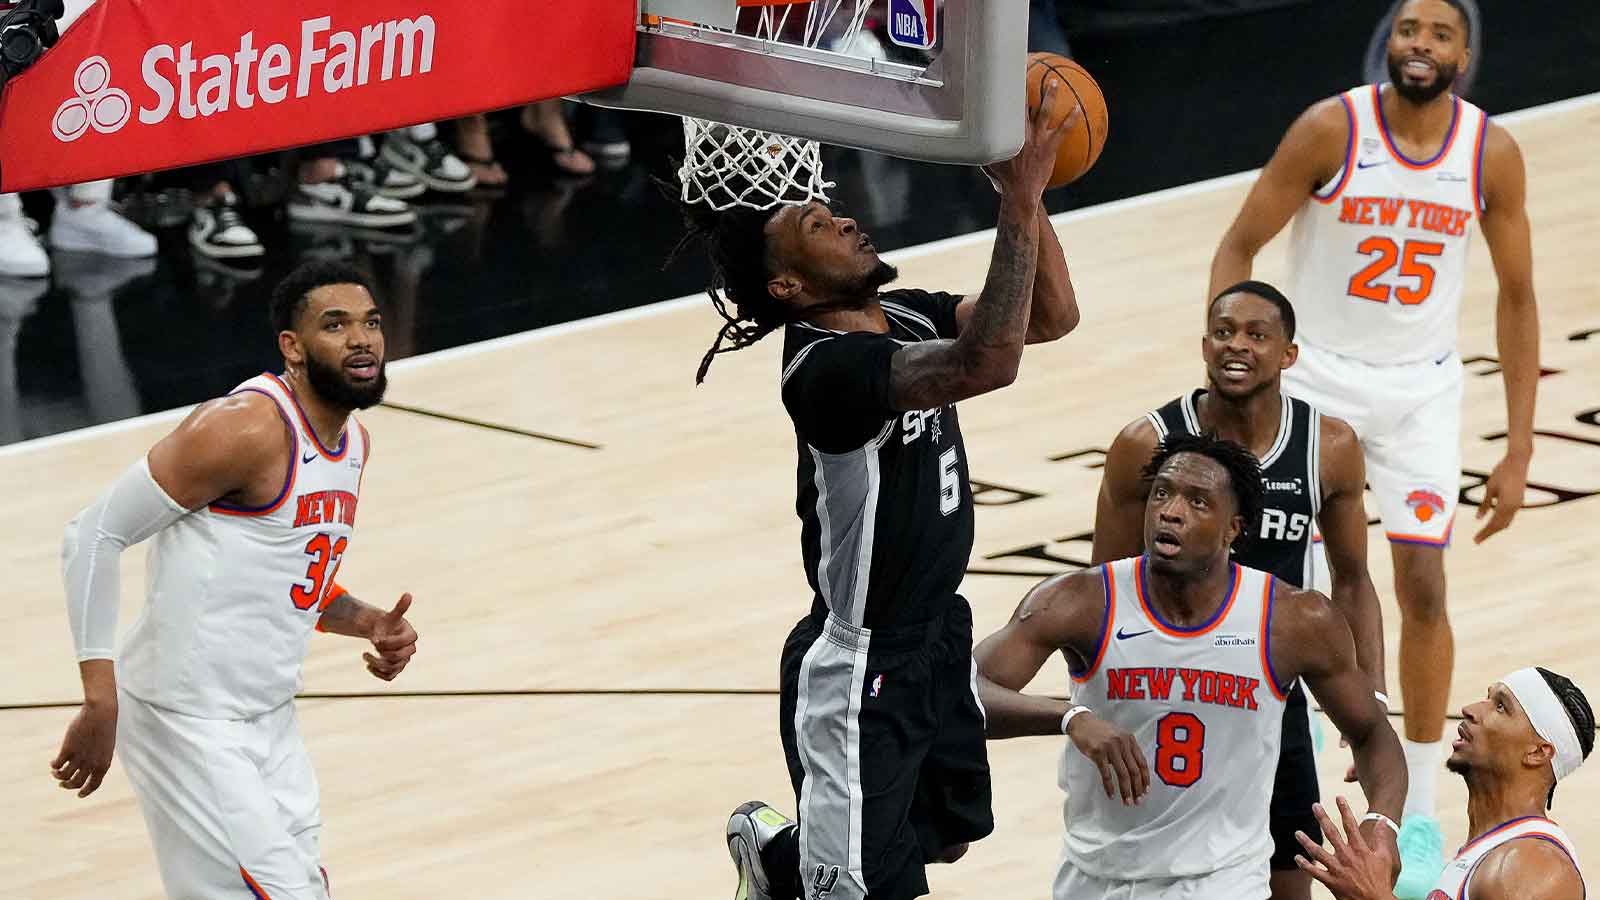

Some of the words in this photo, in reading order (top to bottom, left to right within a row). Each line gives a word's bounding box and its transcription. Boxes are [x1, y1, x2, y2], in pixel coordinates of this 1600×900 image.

[895, 12, 919, 38] NBA
[1338, 196, 1403, 226] NEW
[1406, 199, 1472, 237] YORK
[1347, 235, 1445, 306] 25
[939, 445, 961, 517] 5
[1266, 481, 1298, 491] LEDGER
[293, 490, 336, 528] NEW
[289, 532, 348, 613] 32
[1106, 667, 1175, 700] NEW
[1176, 668, 1260, 711] YORK
[1154, 711, 1206, 788] 8
